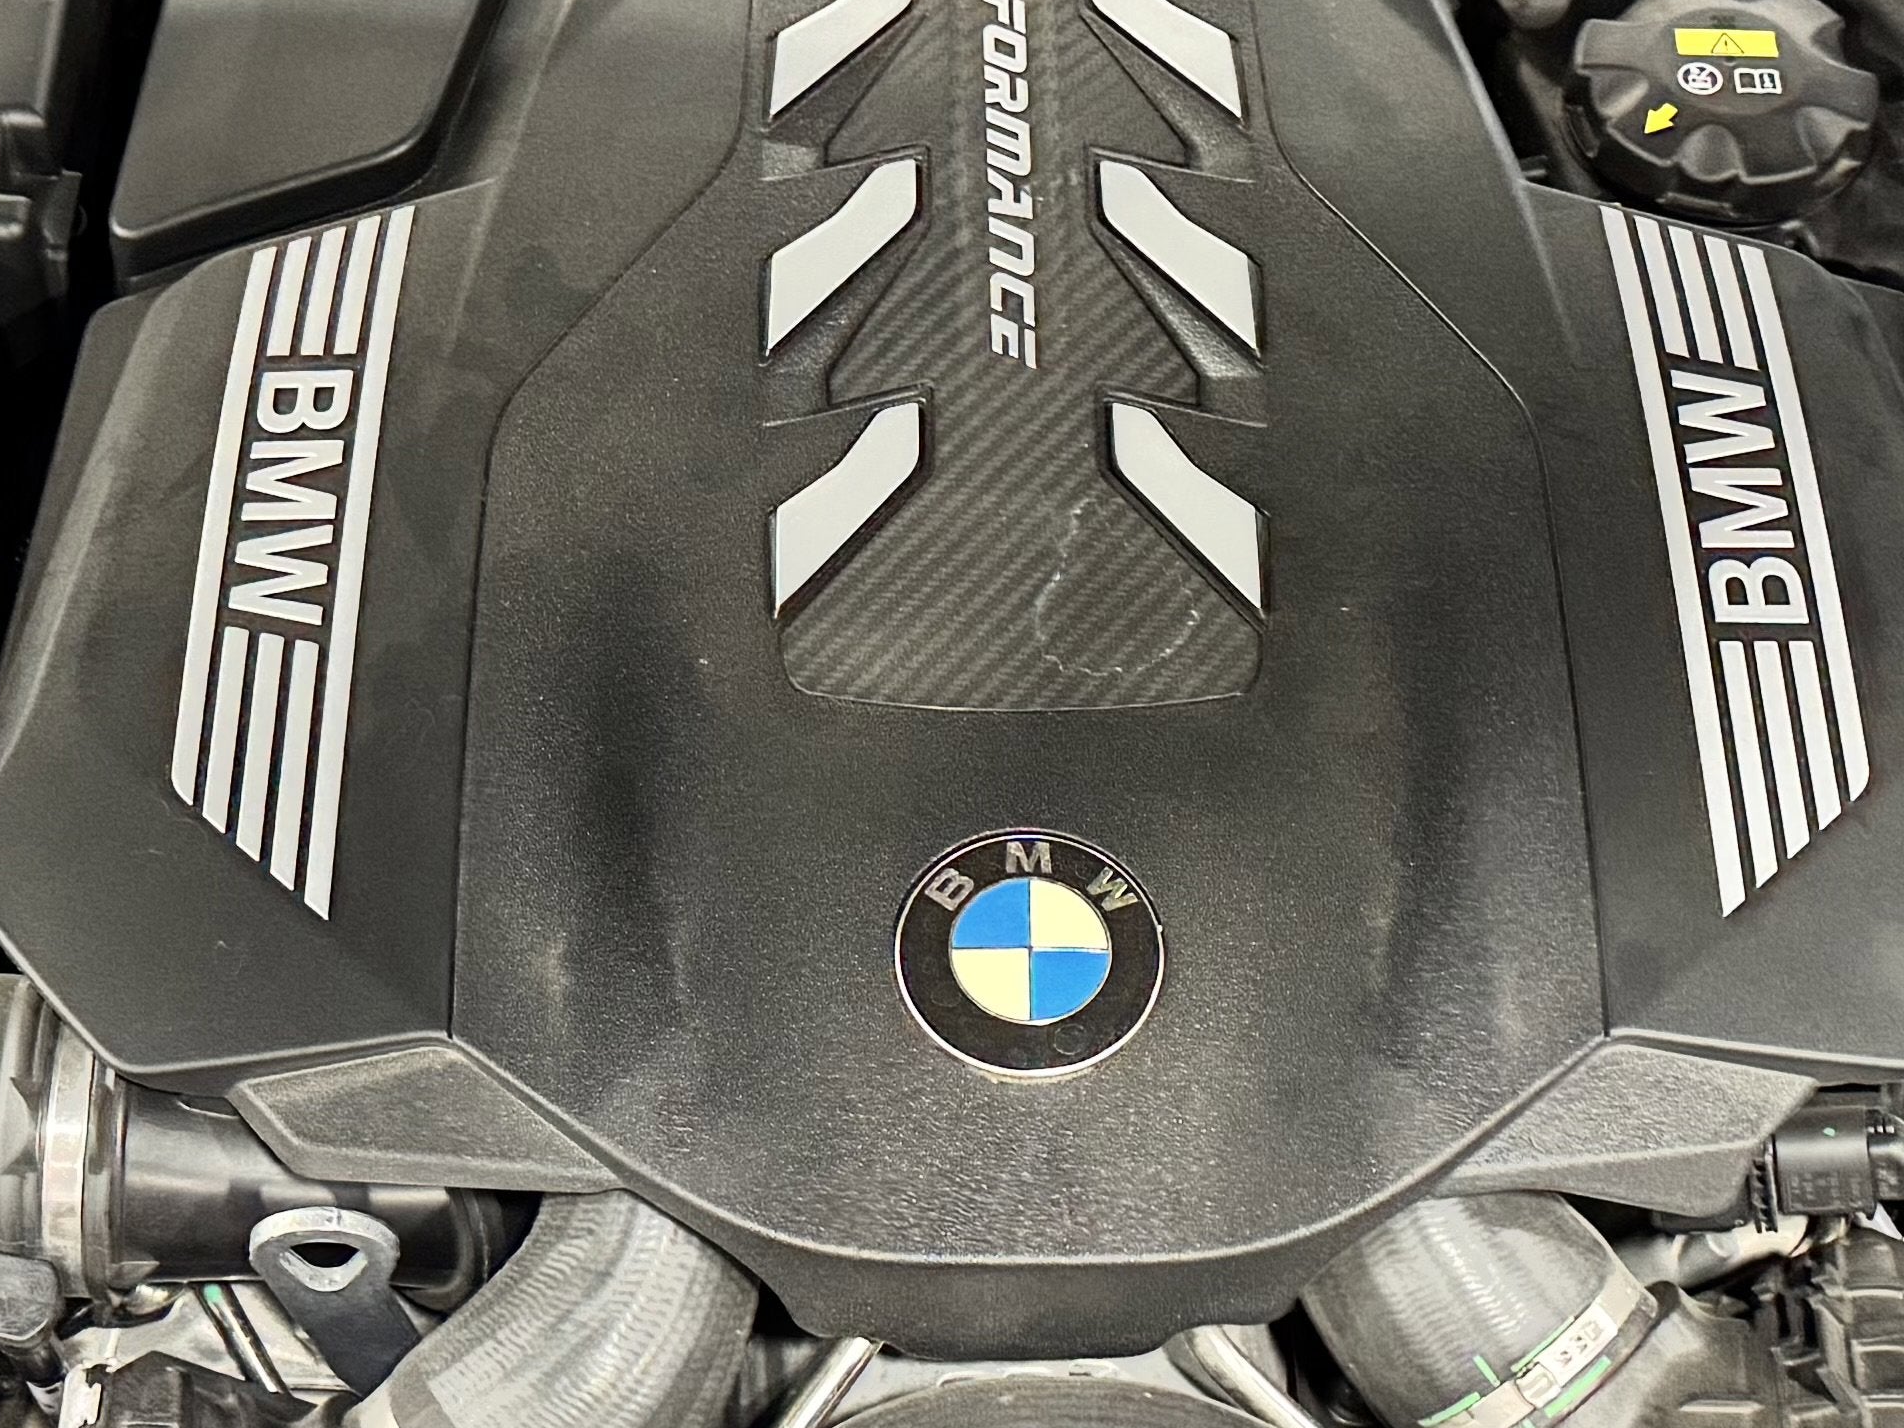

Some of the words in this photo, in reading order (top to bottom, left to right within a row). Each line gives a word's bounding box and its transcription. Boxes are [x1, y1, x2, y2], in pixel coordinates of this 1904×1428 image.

[228, 368, 354, 626] BMW
[1669, 369, 1810, 624] BMW
[924, 840, 1139, 912] BMW
